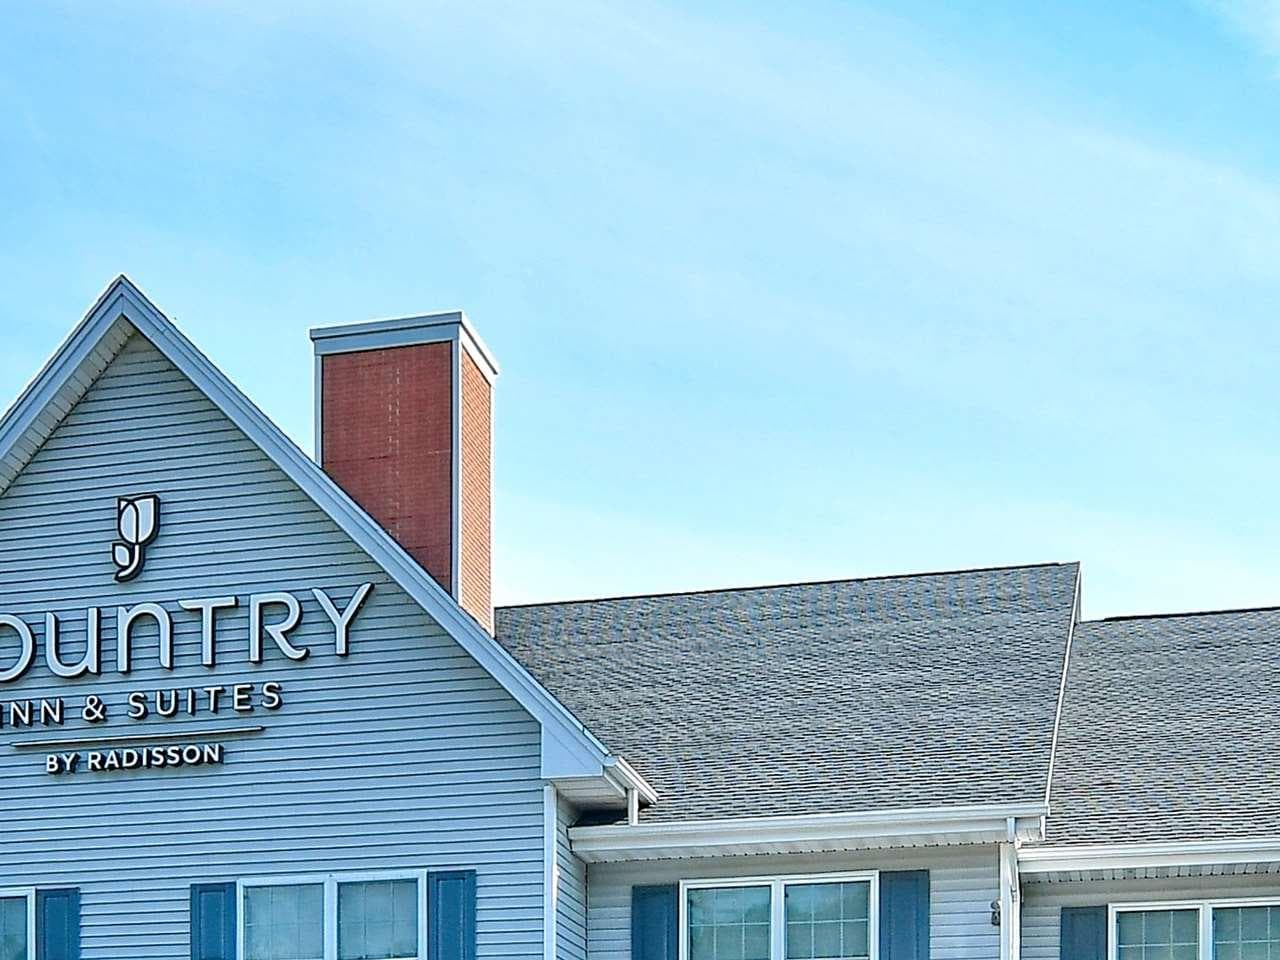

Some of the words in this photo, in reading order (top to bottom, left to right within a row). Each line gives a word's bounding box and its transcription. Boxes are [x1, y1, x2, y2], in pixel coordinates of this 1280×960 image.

[81, 694, 107, 722] &
[127, 681, 283, 720] SUITES
[45, 753, 80, 774] BY
[86, 743, 226, 772] RADISSON
